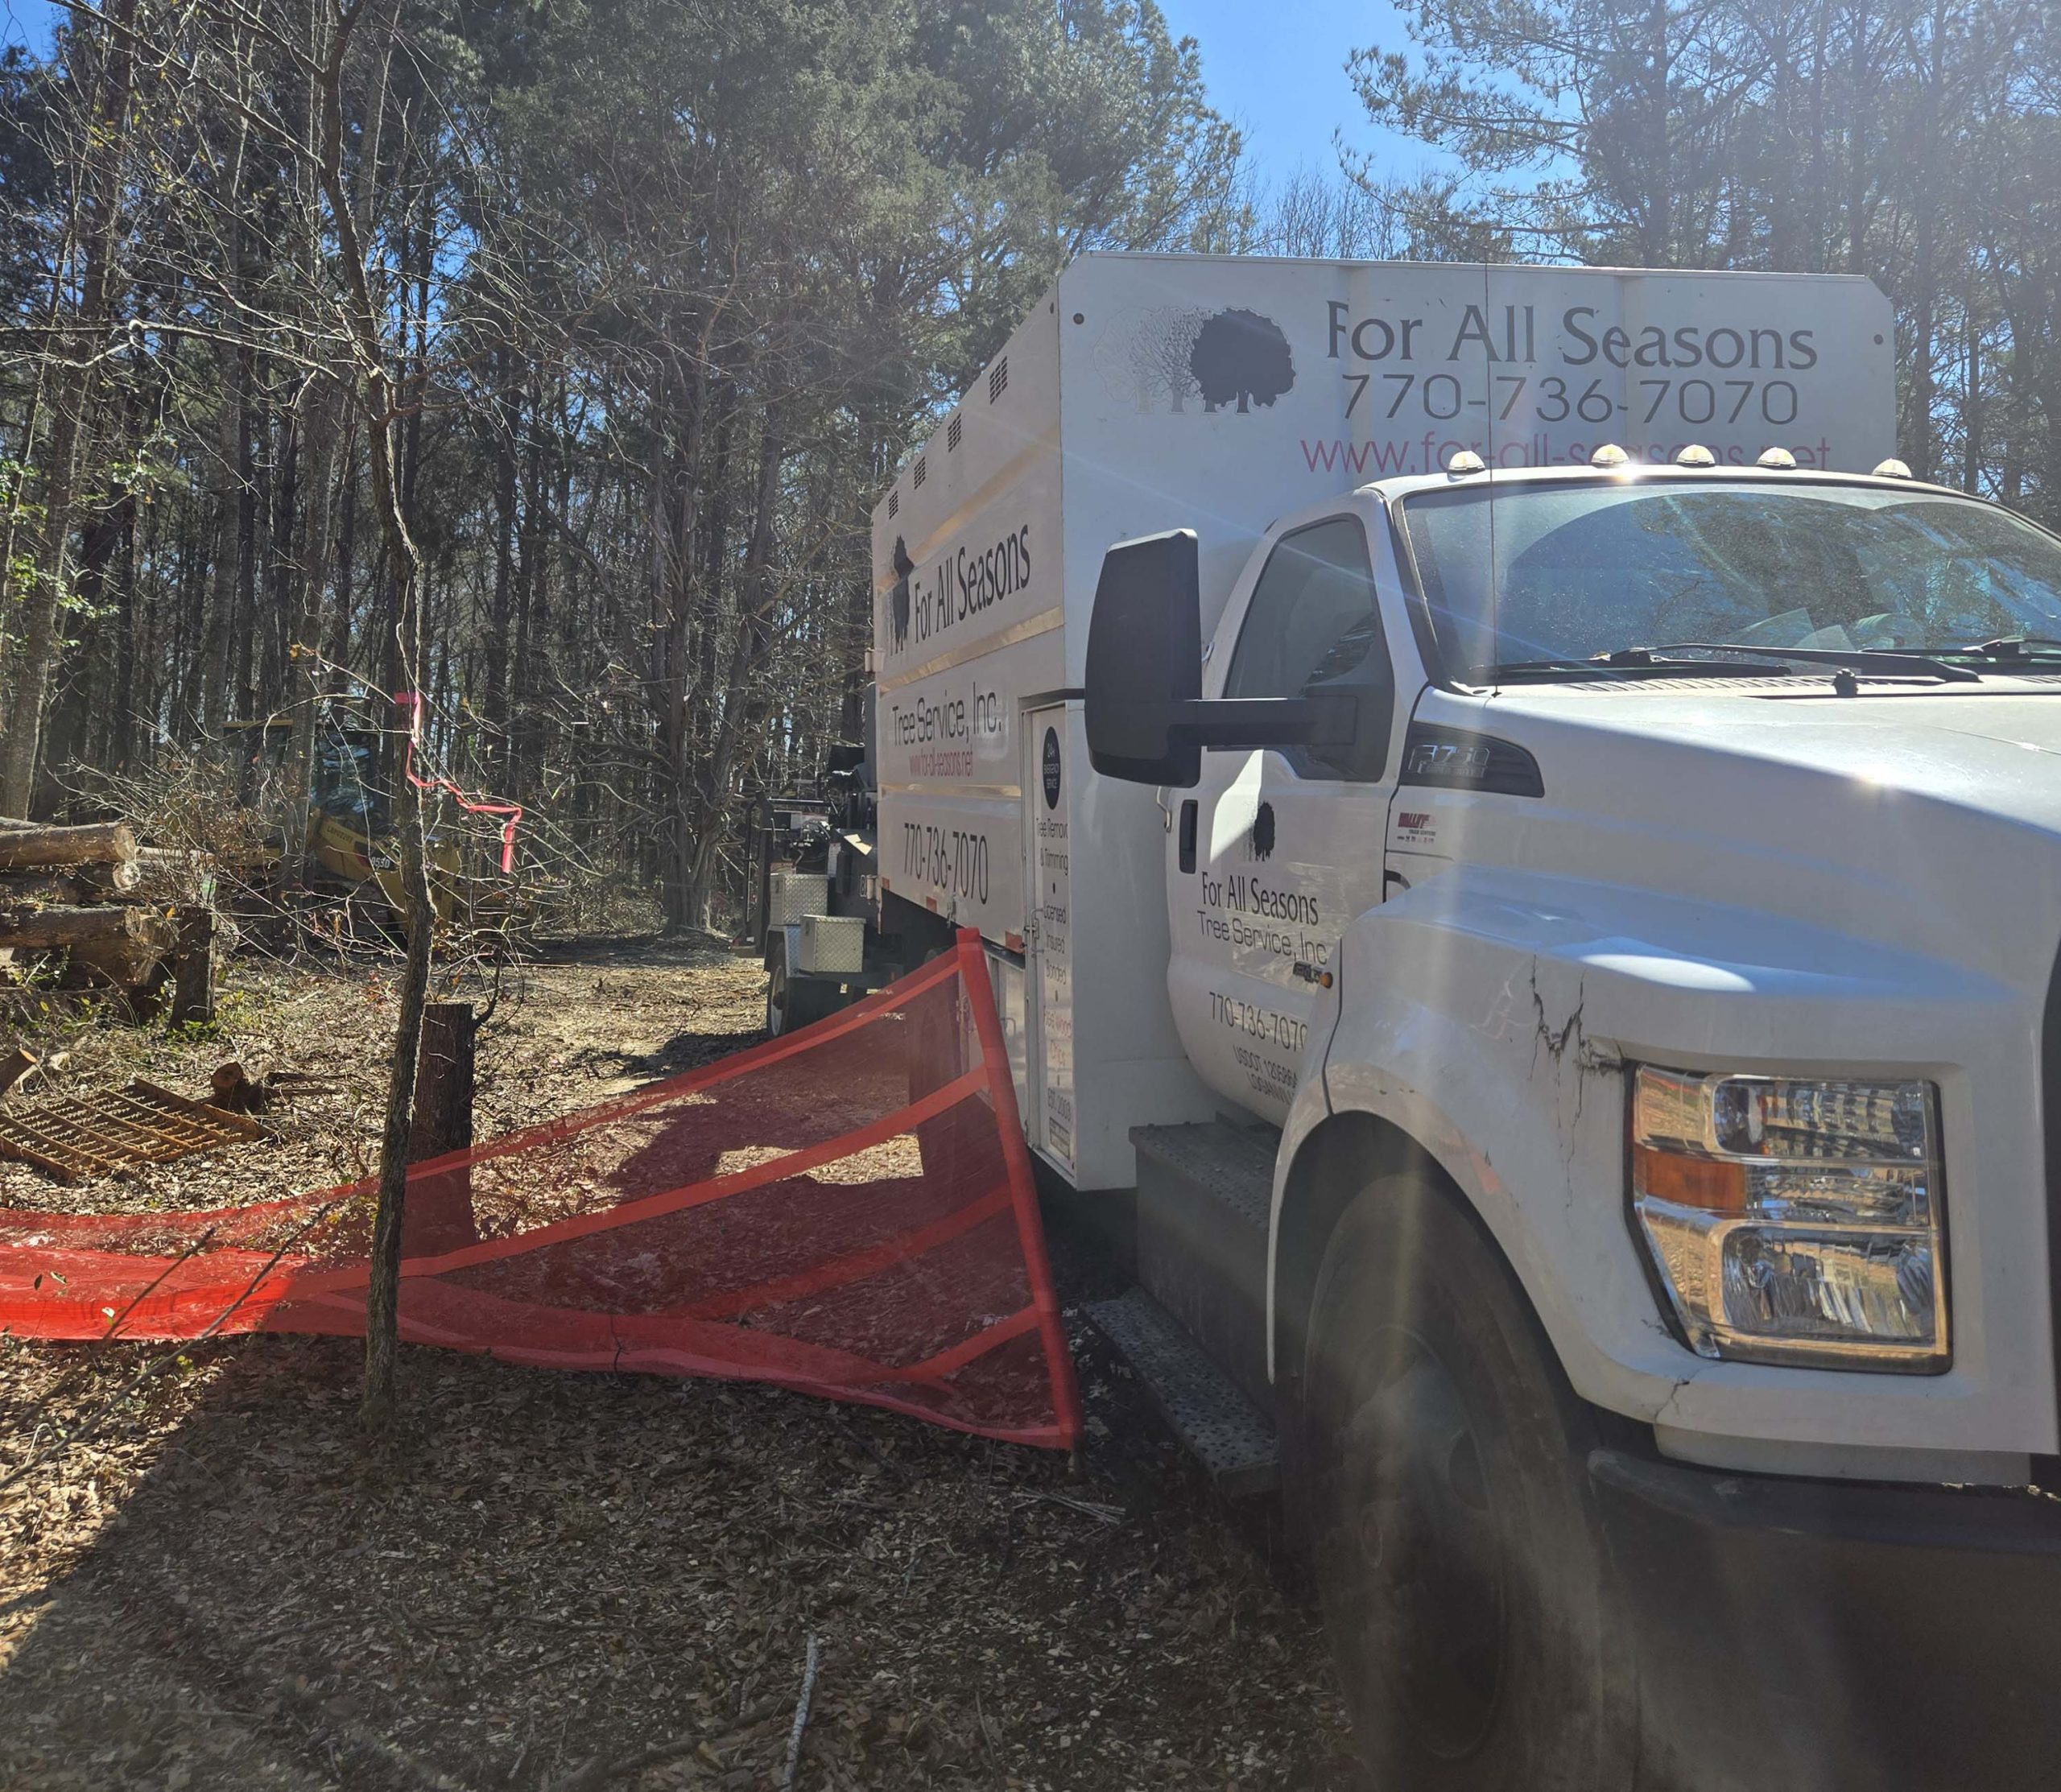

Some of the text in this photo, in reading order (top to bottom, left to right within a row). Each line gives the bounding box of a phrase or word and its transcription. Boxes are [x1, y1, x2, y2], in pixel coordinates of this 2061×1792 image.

[1327, 301, 1818, 370] For All Seasons
[1343, 374, 1799, 425] 770-736-7070
[915, 524, 1030, 643] For All Seasons
[892, 681, 1002, 746] Tree Service, Inc.
[370, 856, 390, 869] 953D
[904, 823, 989, 905] 770-736-7070
[1202, 871, 1319, 926] For All Seasons
[1196, 910, 1230, 941] Tree
[1232, 918, 1297, 962] Service,
